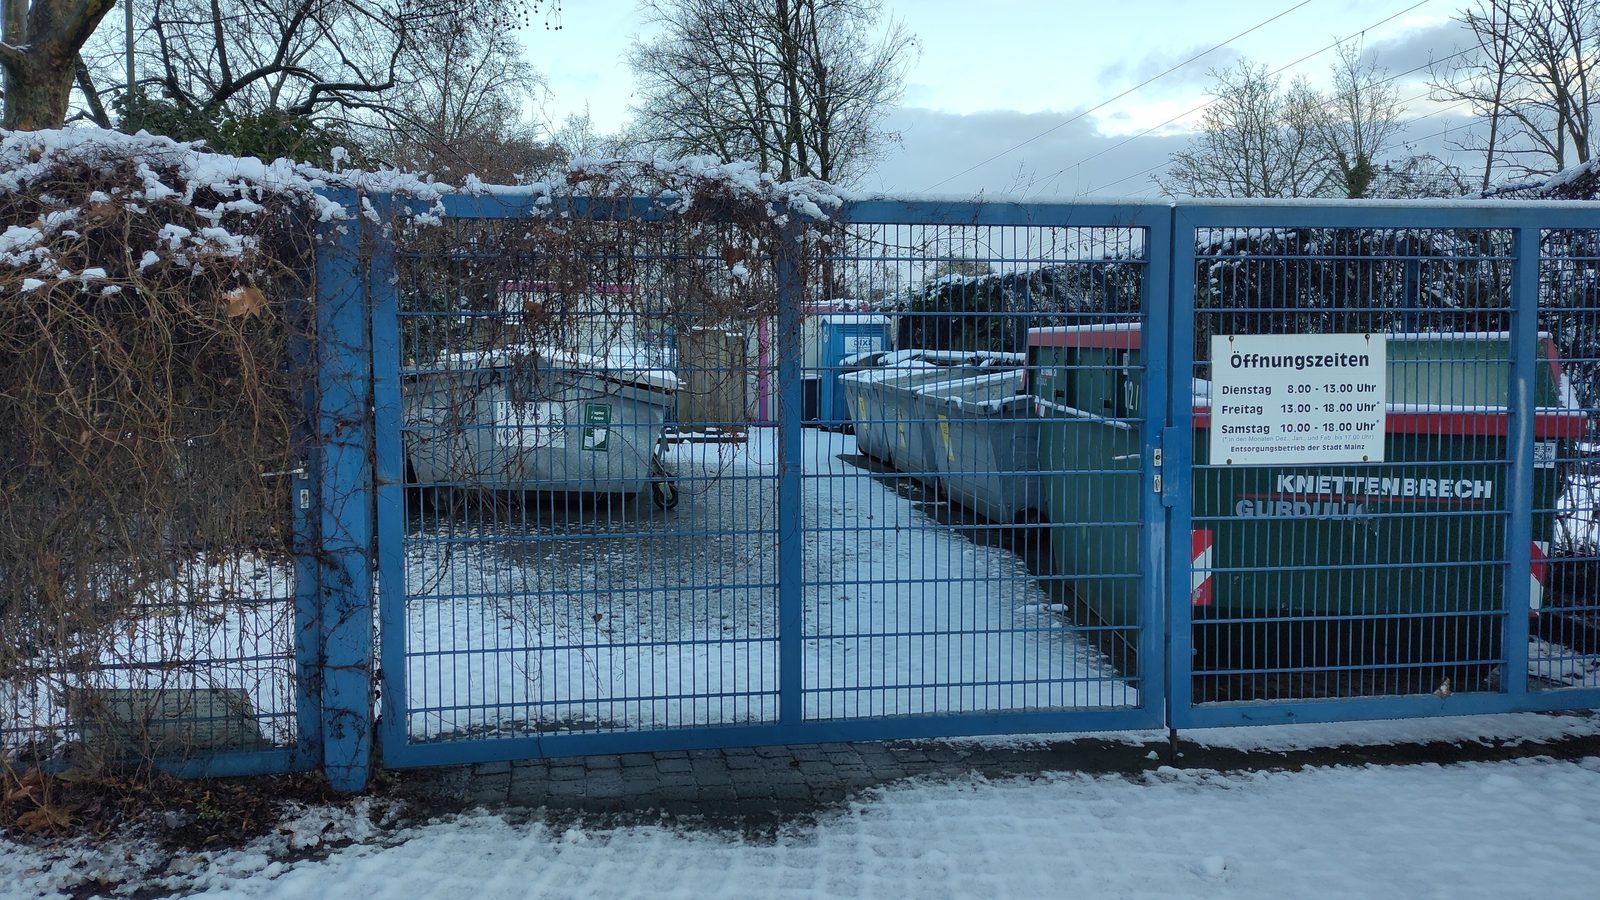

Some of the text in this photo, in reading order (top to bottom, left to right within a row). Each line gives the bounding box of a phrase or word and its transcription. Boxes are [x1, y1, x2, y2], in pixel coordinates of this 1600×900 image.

[1230, 350, 1369, 370] Öffnungszeiten
[1222, 385, 1272, 395] Dienstag
[1287, 384, 1311, 394] 8.00
[1323, 383, 1353, 393] 13.00
[1357, 383, 1377, 393] Uhr
[1221, 405, 1263, 415] Freitag
[1280, 404, 1311, 413] 13.00
[1323, 403, 1353, 412] 18.00
[1221, 424, 1270, 435] Samstag
[1280, 424, 1311, 433] 10.00
[1322, 422, 1352, 432] 18.00
[1230, 445, 1305, 453] Entsorgungsbetrieb
[1322, 443, 1342, 451] Stadt
[1277, 474, 1492, 499] KNETTENBRECH
